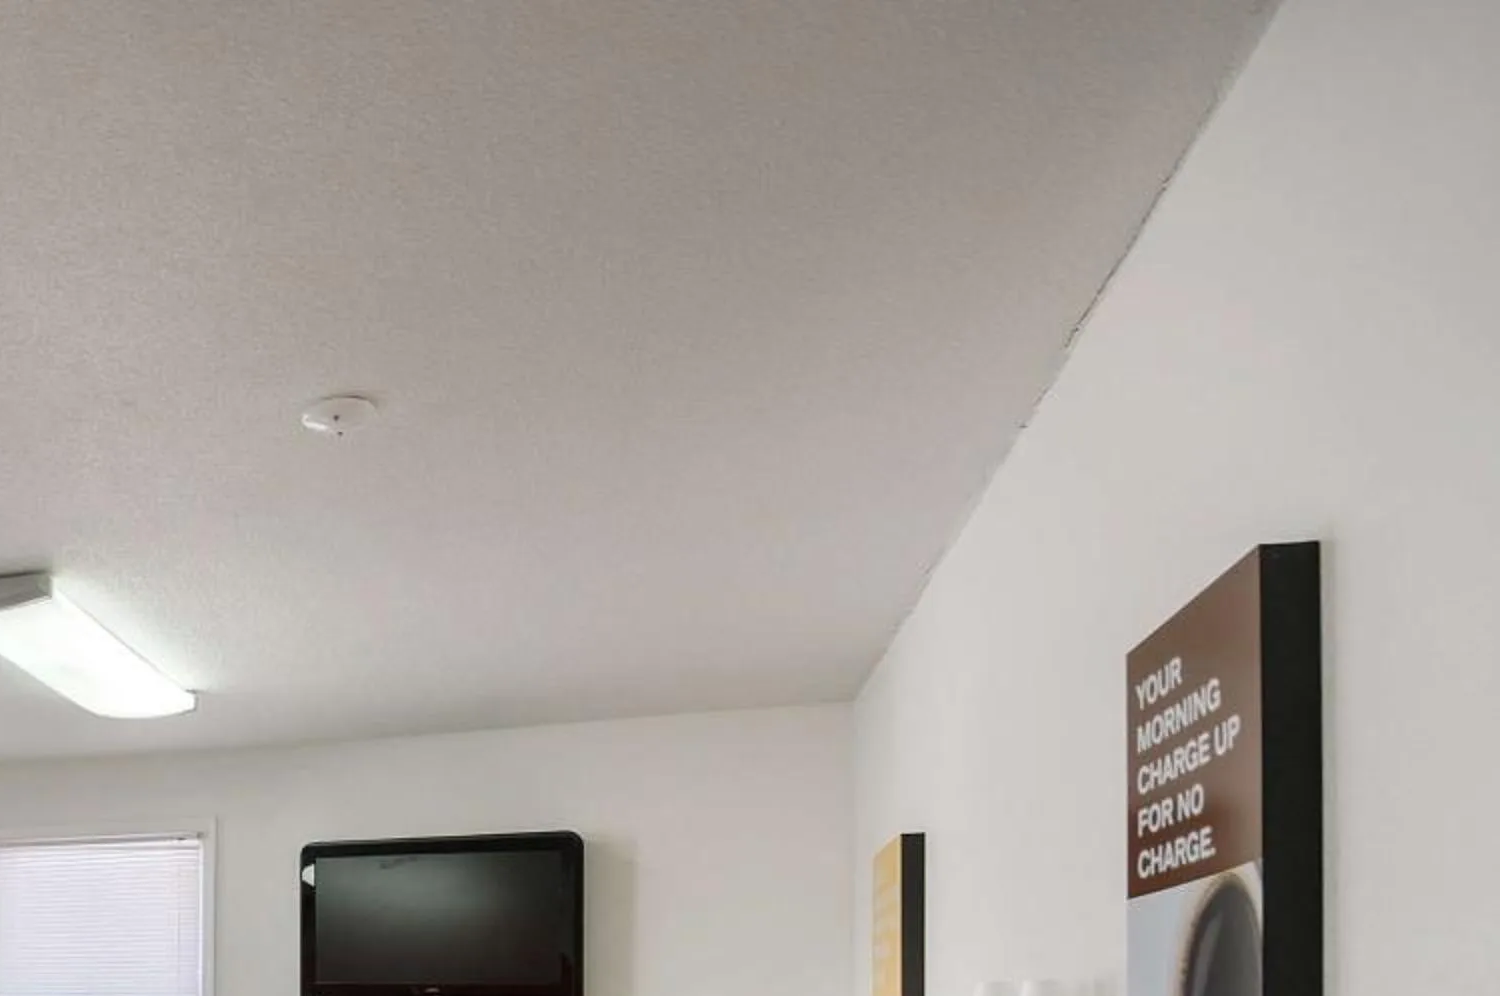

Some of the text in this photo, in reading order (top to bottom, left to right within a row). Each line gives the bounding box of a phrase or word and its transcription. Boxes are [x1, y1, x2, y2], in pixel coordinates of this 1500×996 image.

[1135, 656, 1182, 710] YOUR
[1136, 677, 1222, 753] MORNING
[1137, 714, 1241, 795] CHARGE UP
[1137, 783, 1204, 837] FOR NO
[1137, 825, 1216, 879] CHARGE.
